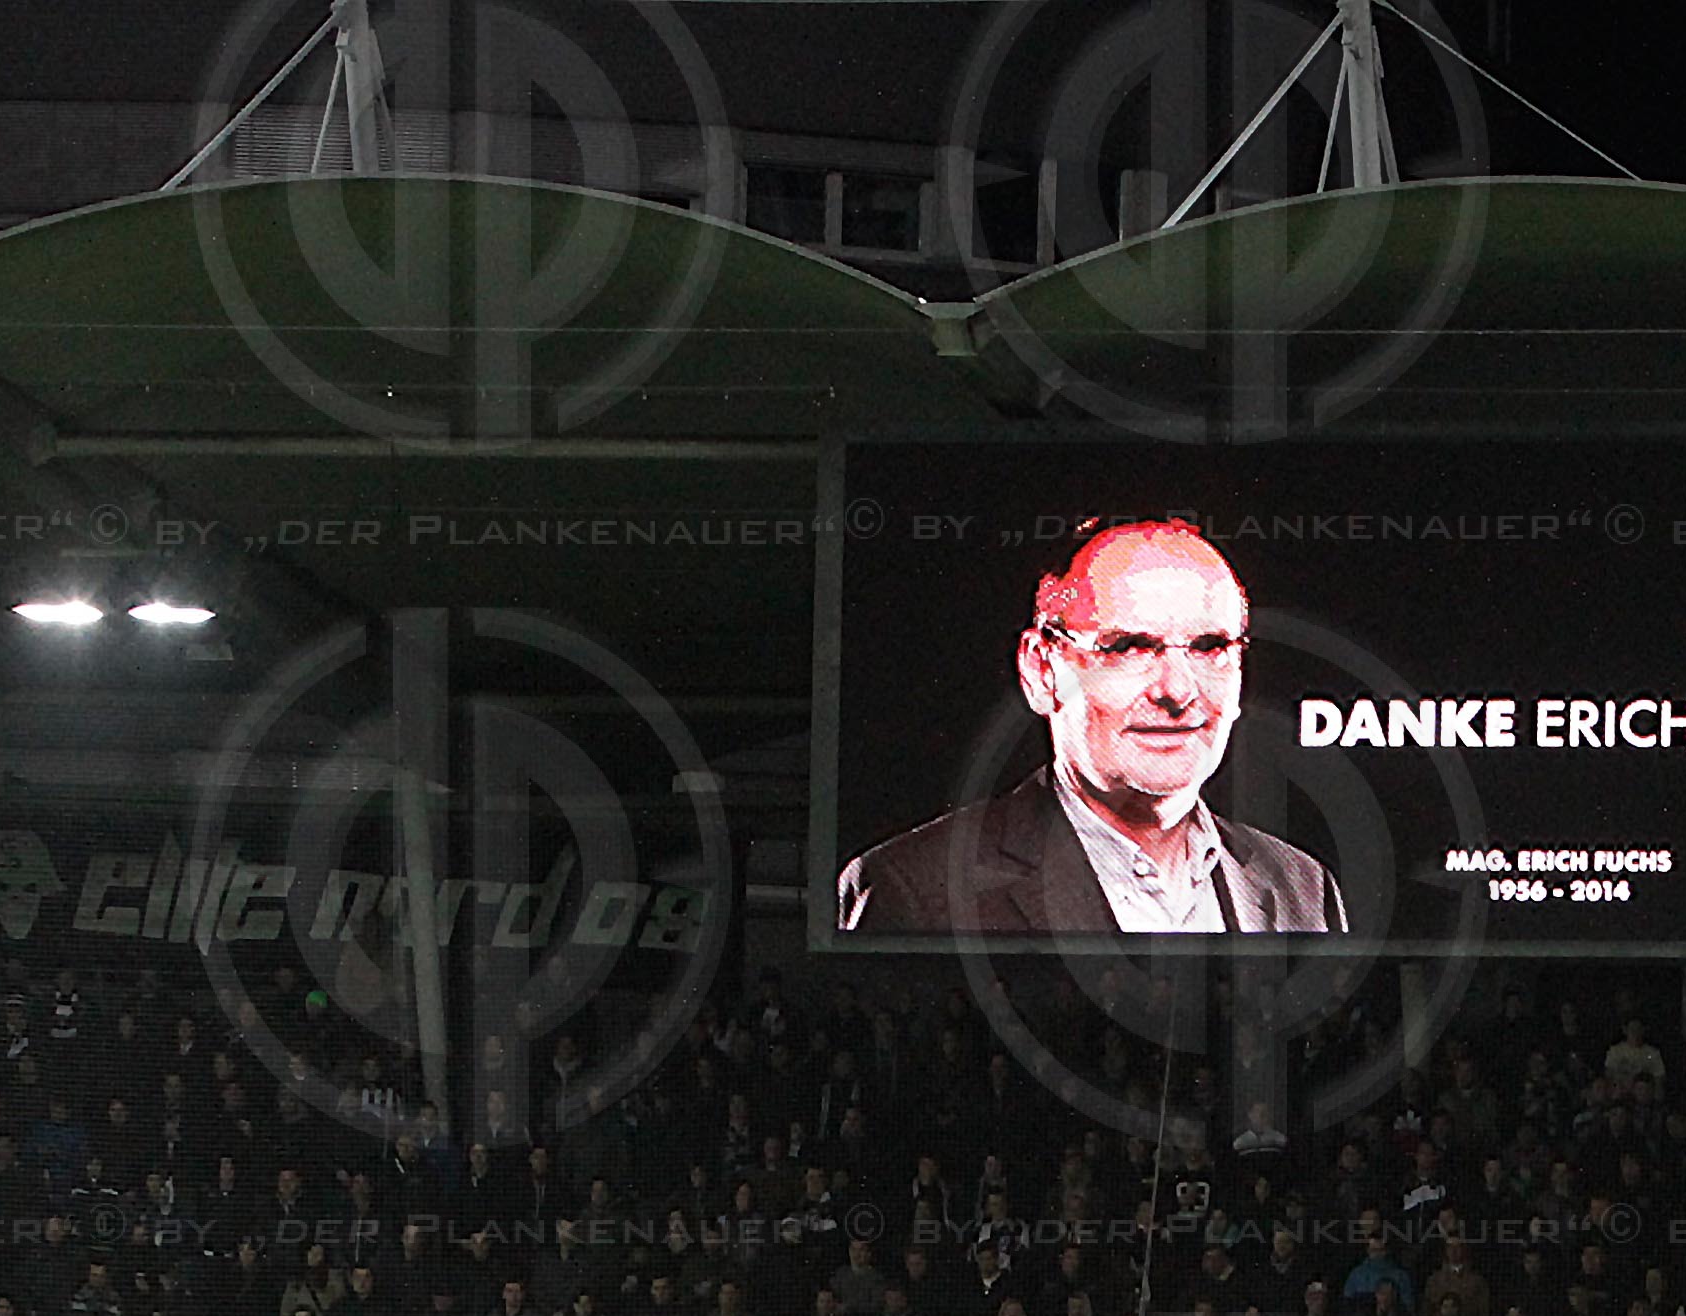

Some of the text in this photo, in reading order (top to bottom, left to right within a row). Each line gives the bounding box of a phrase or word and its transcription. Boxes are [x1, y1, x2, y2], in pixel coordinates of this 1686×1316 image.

[1298, 699, 1515, 748] DANKE
[1445, 849, 1672, 872] MAG. ERICH FUCHS
[1488, 879, 1548, 902] 1956
[1569, 879, 1631, 902] 2014
